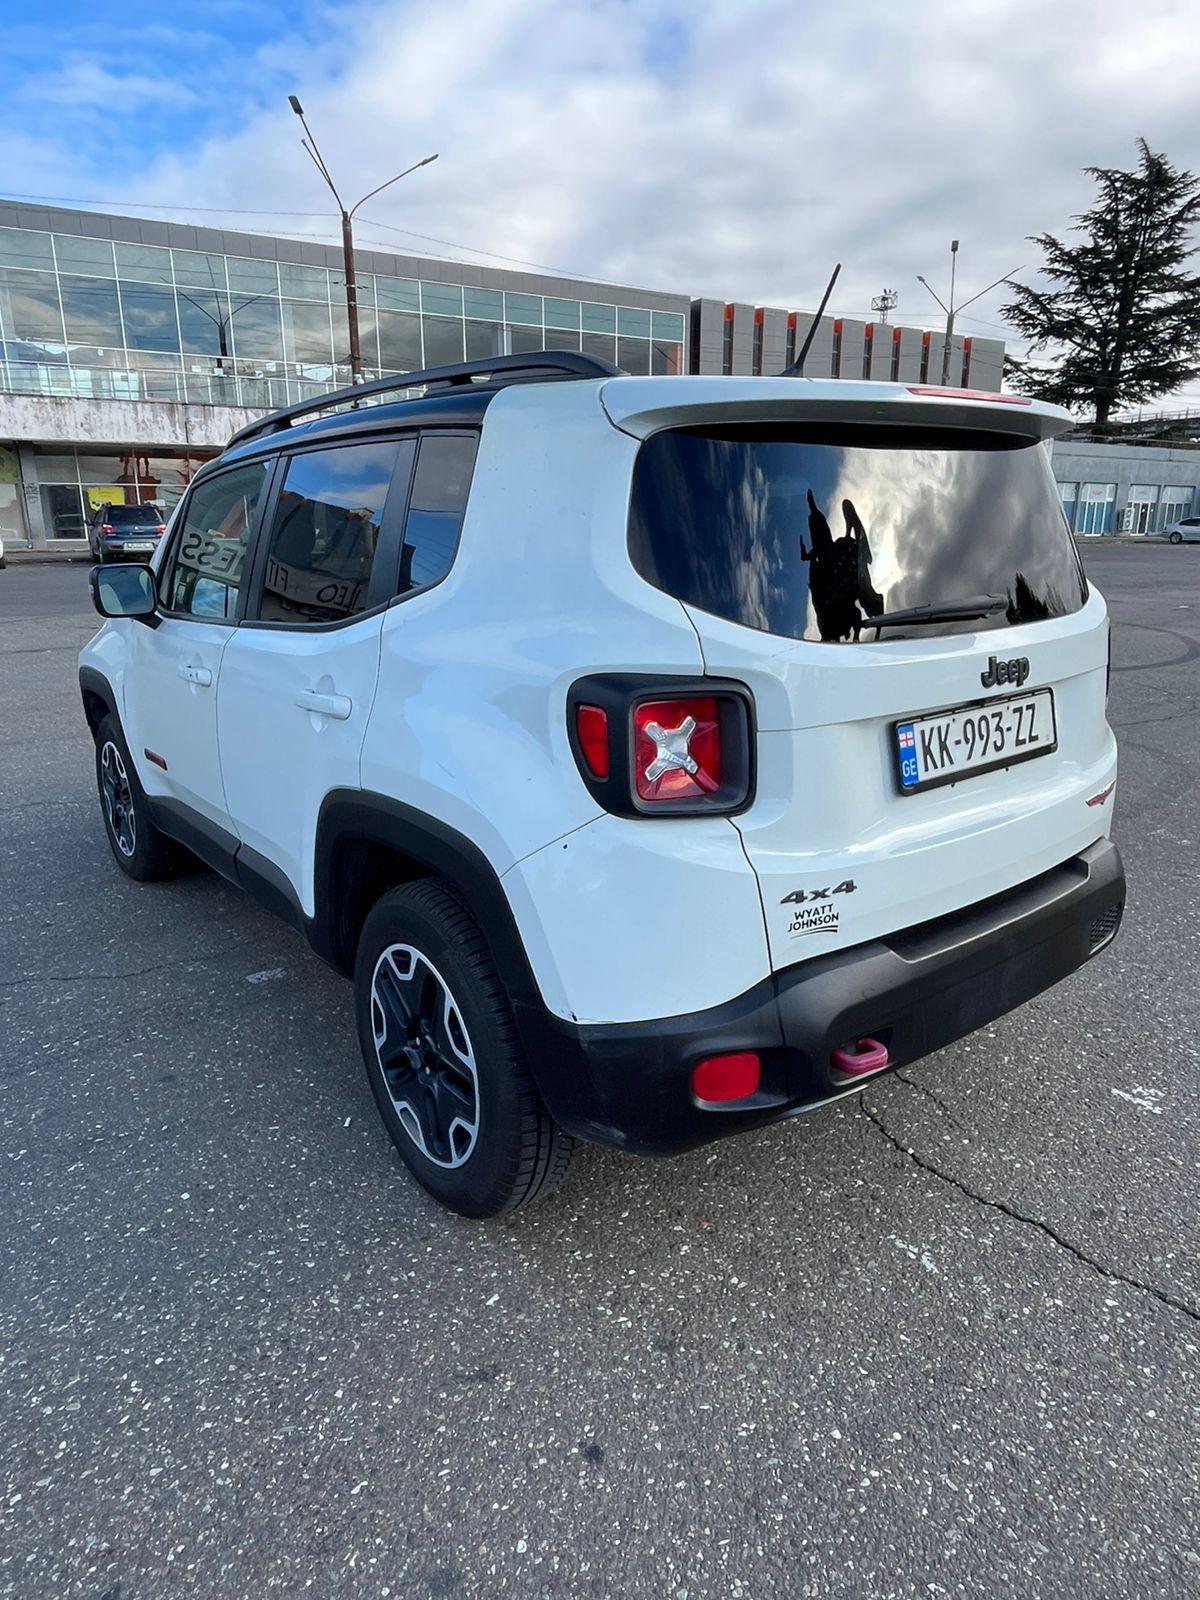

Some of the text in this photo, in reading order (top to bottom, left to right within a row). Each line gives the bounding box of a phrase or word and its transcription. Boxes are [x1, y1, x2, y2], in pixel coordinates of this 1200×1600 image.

[981, 656, 1030, 688] Jeep
[920, 703, 1039, 772] KK-993-ZZ
[902, 759, 917, 777] GE
[780, 879, 857, 904] 4x4
[788, 912, 839, 932] JOHNSON
[794, 903, 833, 920] WYATT
